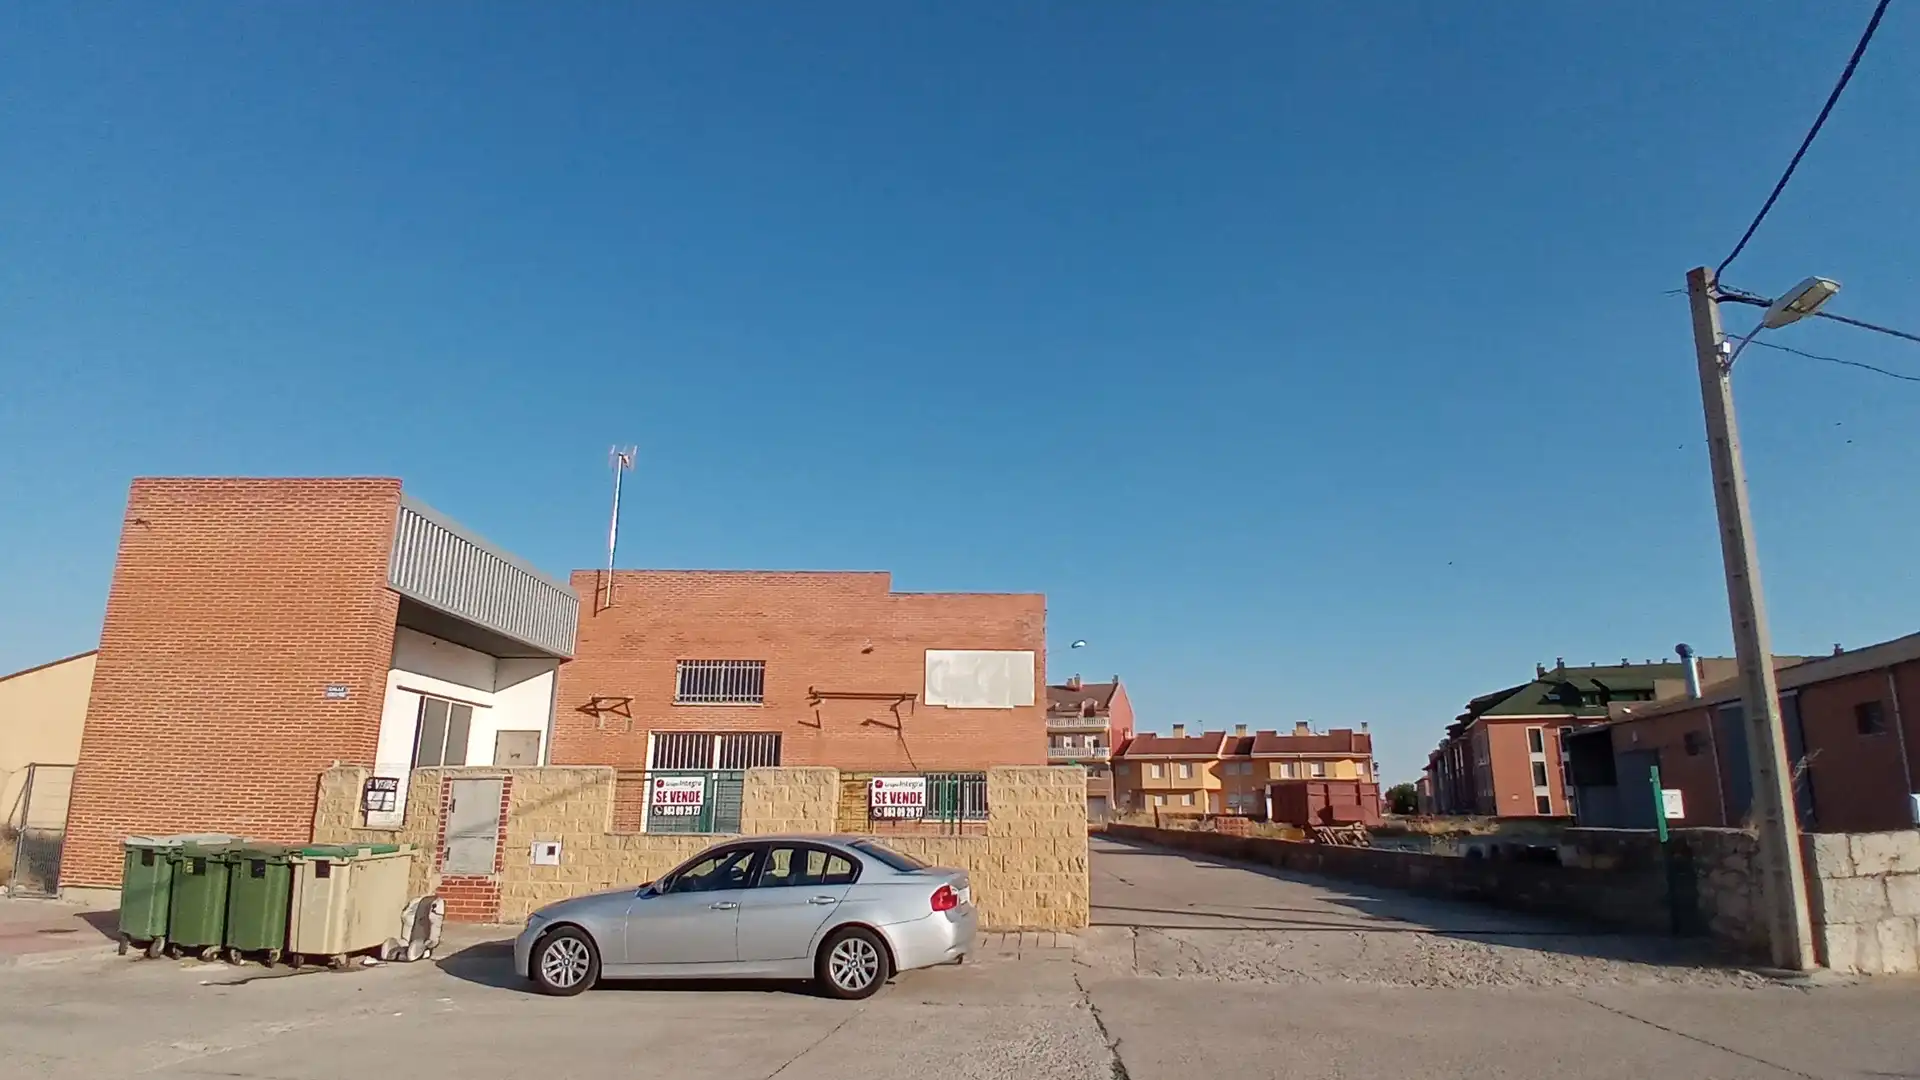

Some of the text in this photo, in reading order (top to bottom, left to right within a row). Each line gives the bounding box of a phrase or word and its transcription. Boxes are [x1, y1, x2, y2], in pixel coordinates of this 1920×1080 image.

[656, 790, 701, 803] SE VENDE
[875, 791, 922, 804] SE VENDE
